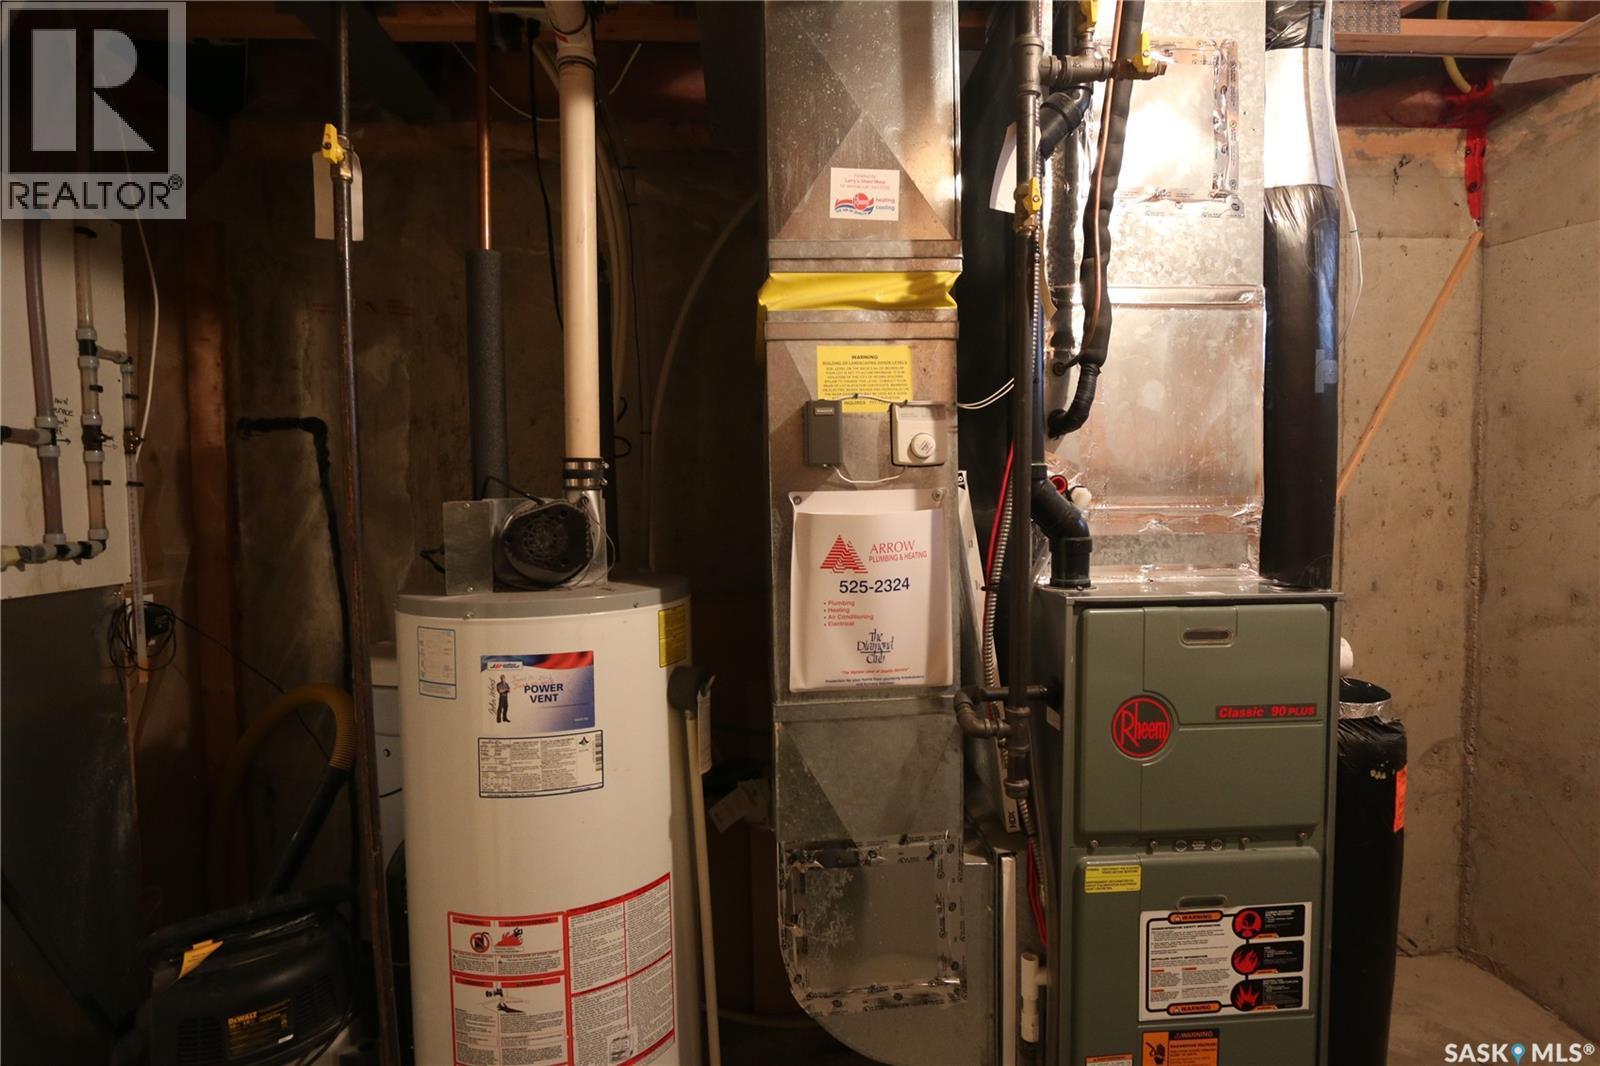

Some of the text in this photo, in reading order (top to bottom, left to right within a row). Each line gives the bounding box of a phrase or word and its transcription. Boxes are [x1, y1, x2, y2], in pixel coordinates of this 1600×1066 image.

[869, 540, 916, 554] ARROW
[868, 550, 928, 563] PLUMBING & HEATING
[839, 577, 910, 594] 525-2324
[524, 683, 564, 693] POWER
[530, 694, 559, 703] VENT
[1219, 706, 1315, 718] Classic 90 PLUS
[1120, 701, 1168, 748] Rheem
